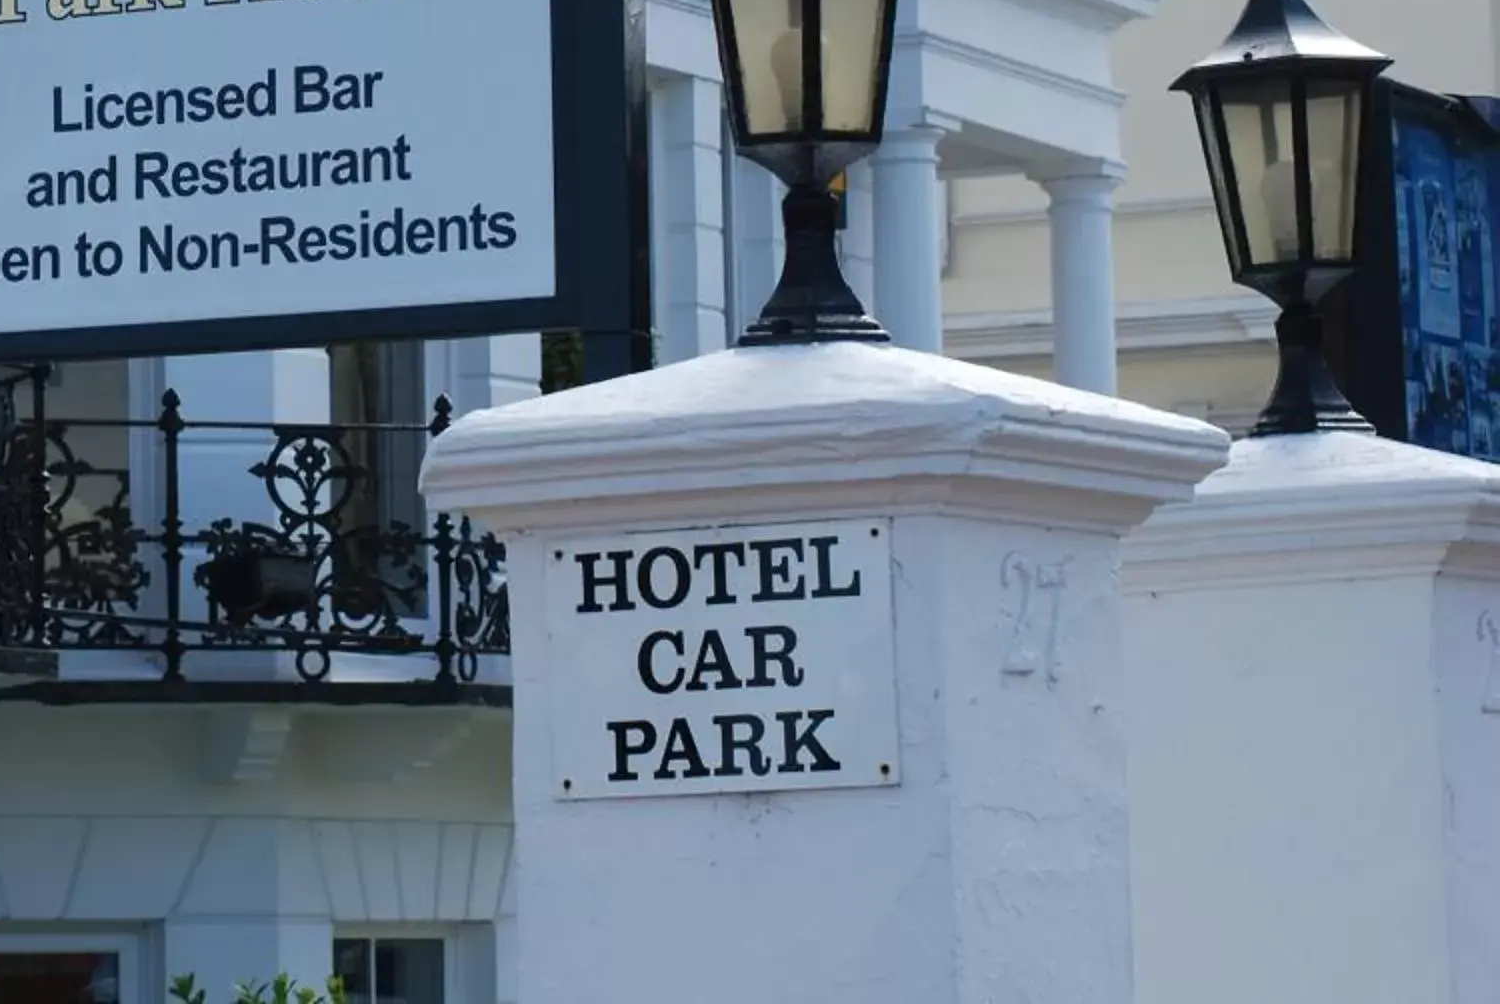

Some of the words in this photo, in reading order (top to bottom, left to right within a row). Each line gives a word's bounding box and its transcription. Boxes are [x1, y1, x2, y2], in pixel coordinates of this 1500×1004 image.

[51, 68, 277, 133] Licensed
[293, 65, 383, 114] Bar
[26, 156, 118, 208] and
[134, 134, 411, 199] Restaurant
[76, 232, 123, 277] to
[139, 203, 517, 274] Non-Residents
[574, 536, 861, 613] HOTEL
[637, 625, 804, 694] CAR
[607, 709, 841, 781] PARK
